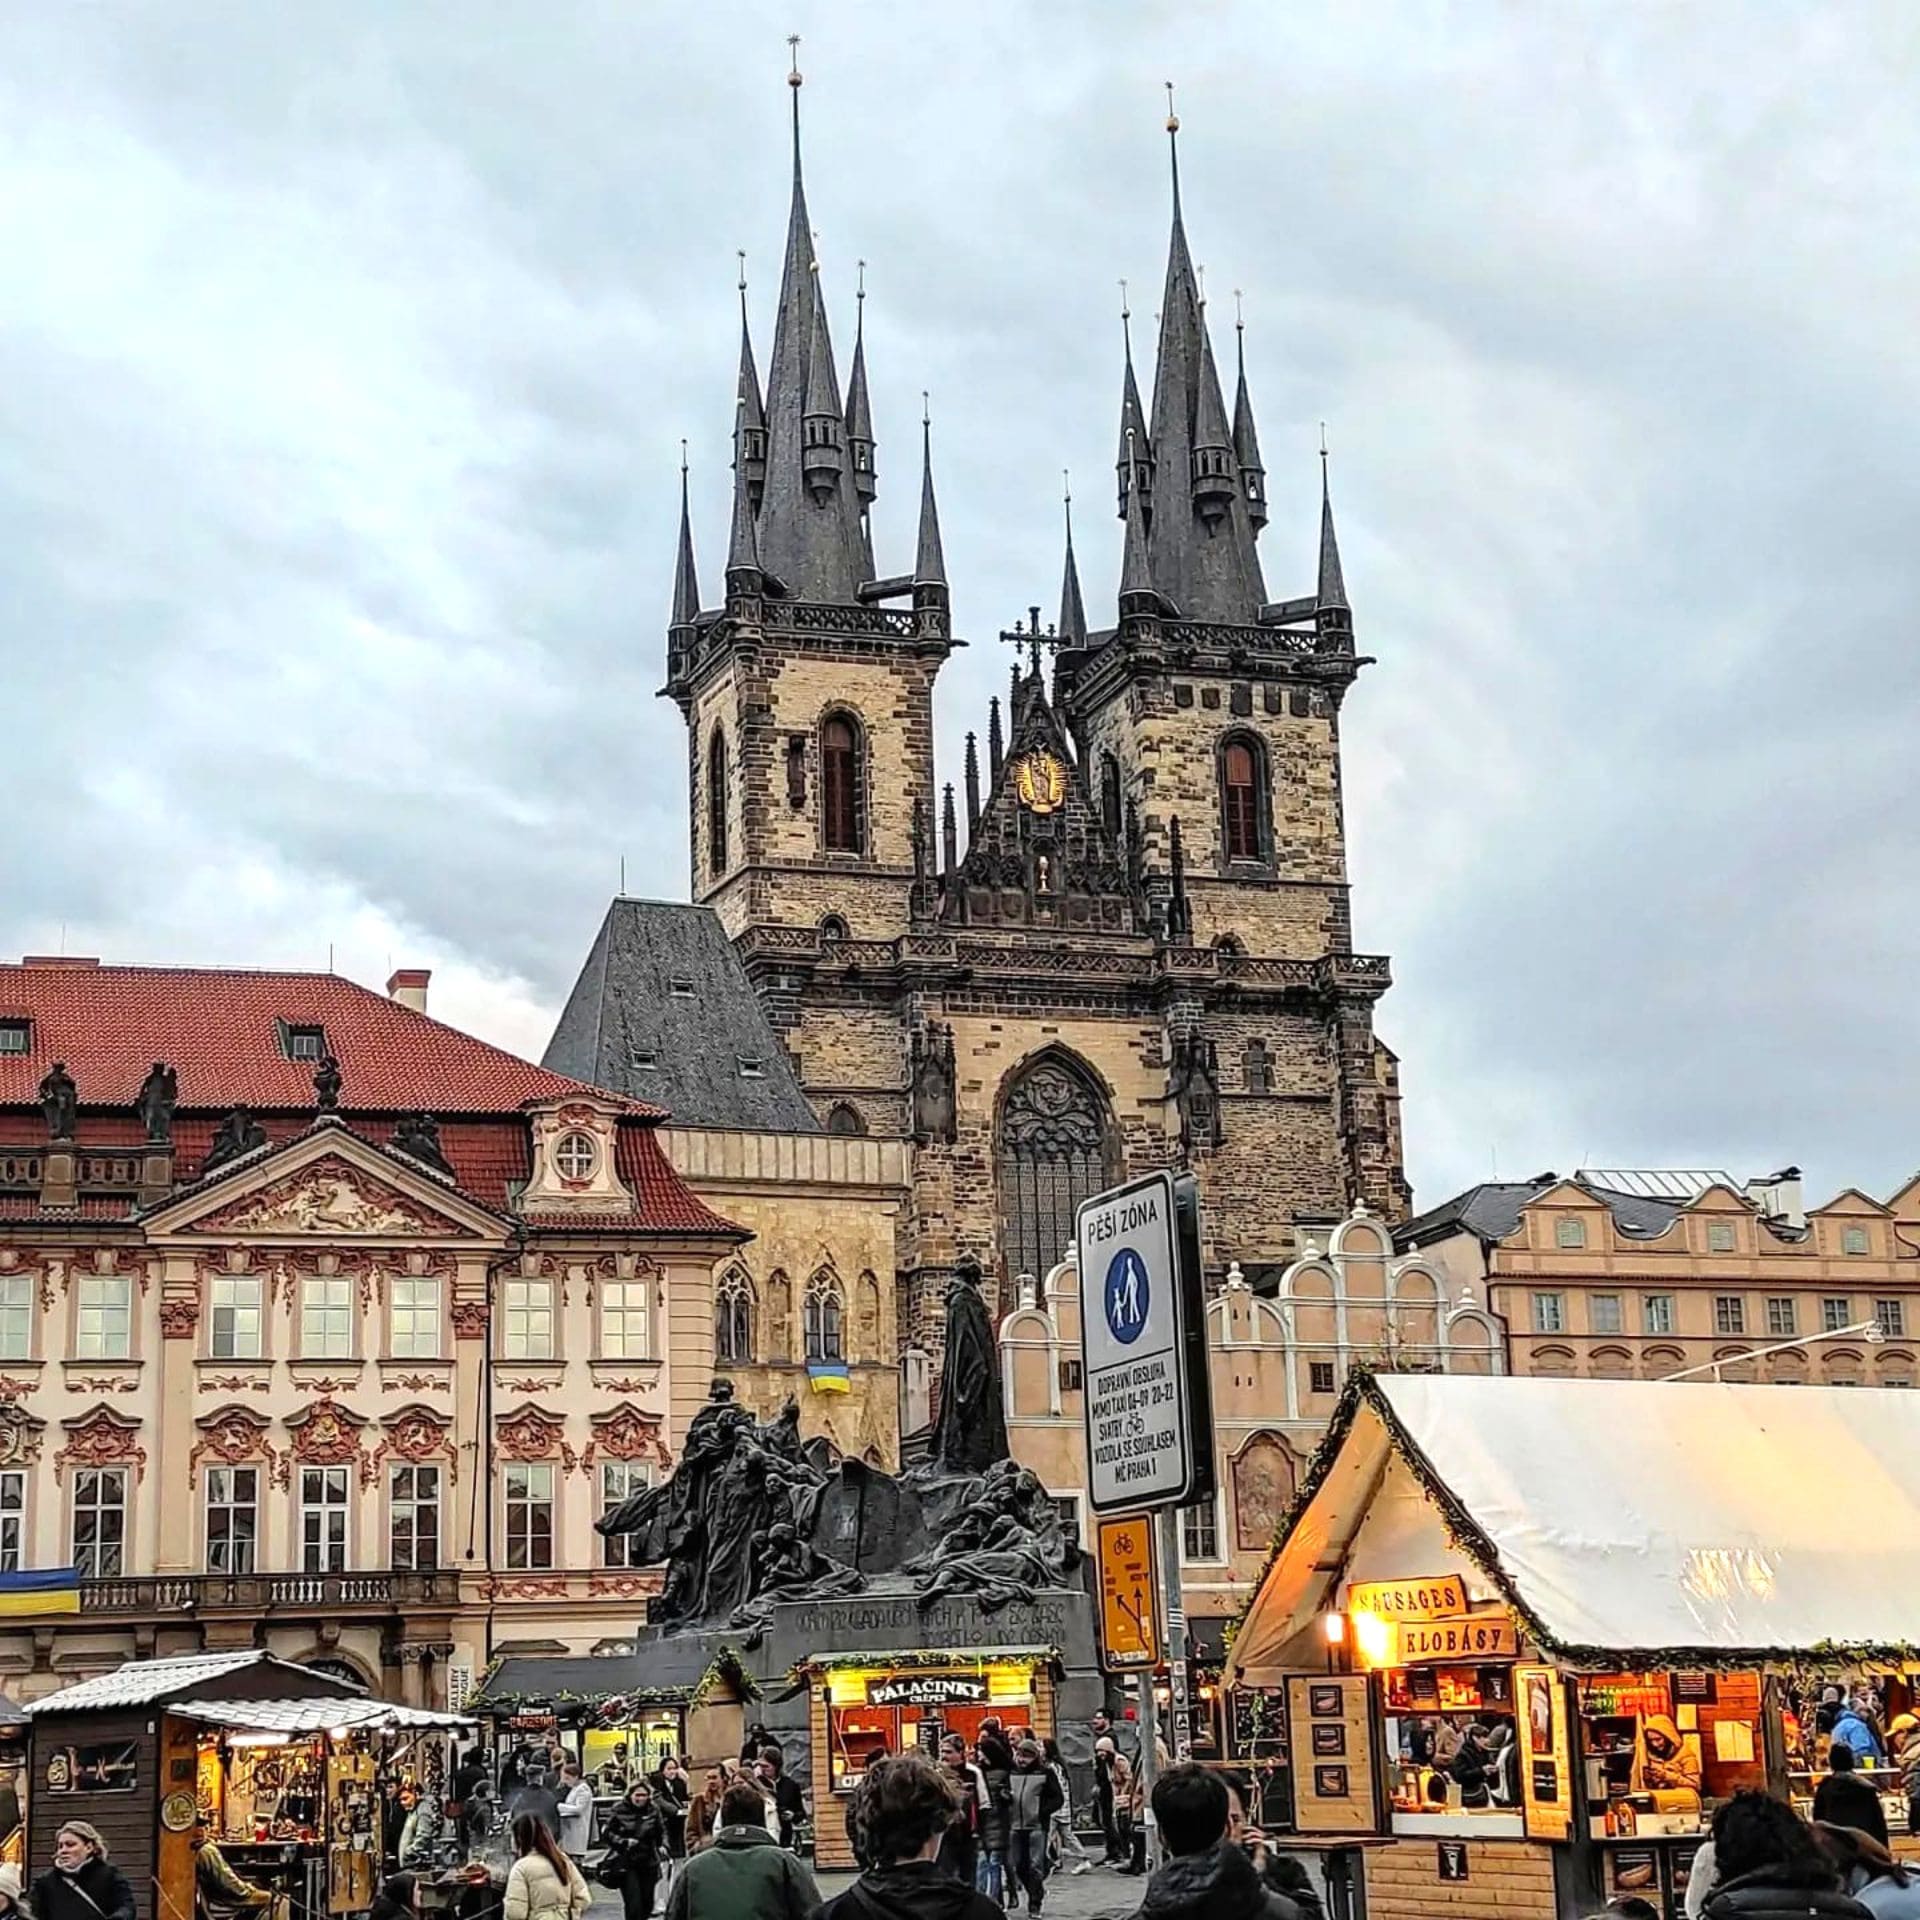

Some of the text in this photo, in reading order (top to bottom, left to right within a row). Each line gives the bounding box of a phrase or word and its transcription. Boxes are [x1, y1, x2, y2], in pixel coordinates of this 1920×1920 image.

[1088, 1200, 1158, 1245] PĚŠÍ ZÓNA
[1127, 1459, 1151, 1481] PRAHA
[1359, 1587, 1456, 1612] SAUSAGES
[1406, 1624, 1502, 1654] KLOBÁSY
[871, 1677, 985, 1704] PALAČINKY
